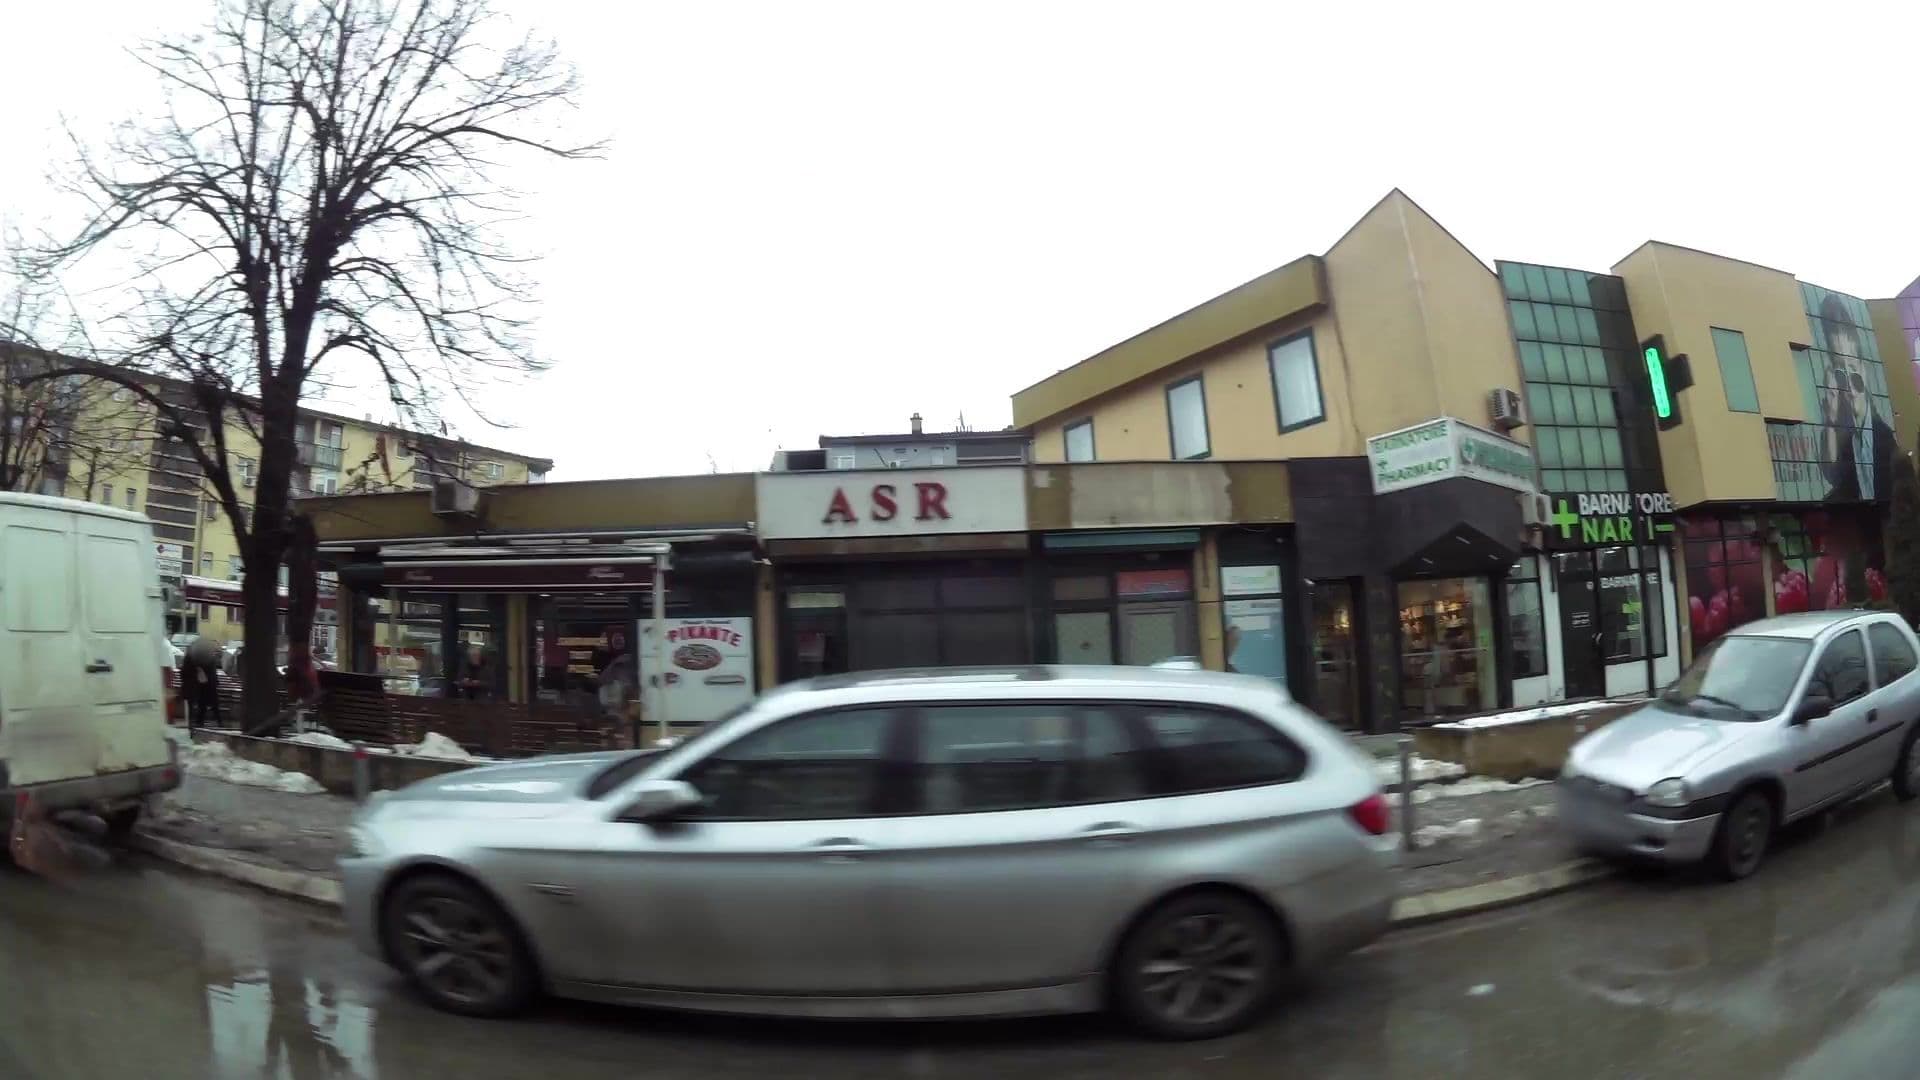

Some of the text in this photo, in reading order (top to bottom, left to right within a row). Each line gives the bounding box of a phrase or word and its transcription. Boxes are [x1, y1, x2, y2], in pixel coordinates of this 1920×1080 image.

[1378, 457, 1451, 485] PHARMACY
[823, 482, 951, 524] ASR
[1577, 493, 1672, 515] BARNAORE
[1582, 517, 1654, 543] NARI
[666, 625, 743, 647] PIKANTE
